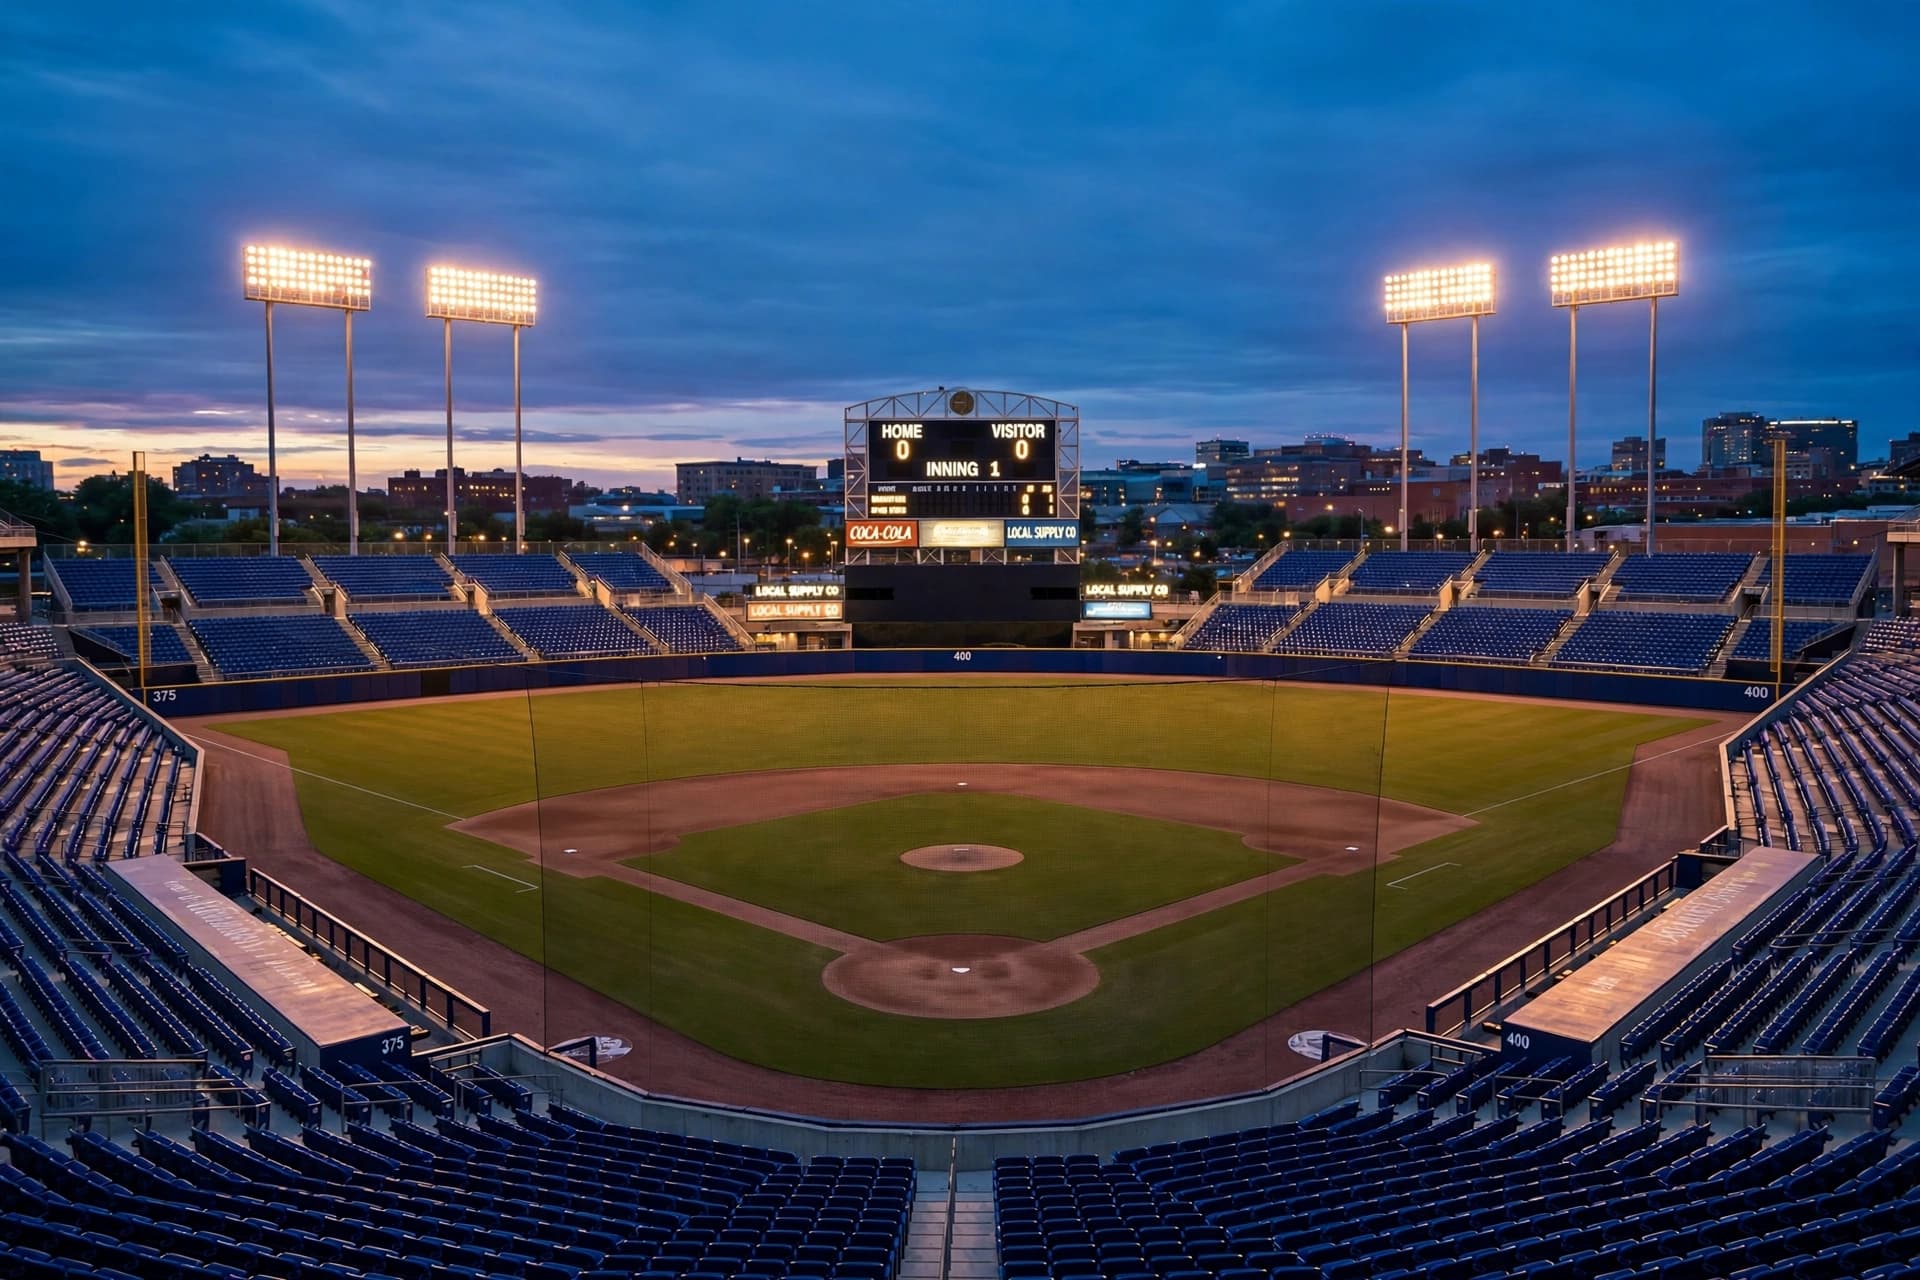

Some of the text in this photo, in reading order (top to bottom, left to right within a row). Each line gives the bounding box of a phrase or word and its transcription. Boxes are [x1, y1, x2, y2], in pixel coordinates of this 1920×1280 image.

[881, 424, 923, 439] HOME
[991, 423, 1046, 439] VISITOR
[896, 440, 910, 460] 0
[1015, 440, 1029, 460] 0
[926, 461, 1000, 477] INNING 1
[850, 525, 912, 540] COCA-COLA
[1007, 526, 1077, 539] LOCAL SUPPLY CO
[755, 585, 839, 597] LOCAL SUPPLY CO
[1086, 584, 1116, 595] LOCAL
[1118, 584, 1154, 595] SUPPLY
[751, 604, 784, 617] LOCAL
[953, 651, 972, 661] 400
[153, 689, 177, 702] 375
[1744, 686, 1769, 699] 400
[382, 1035, 404, 1055] 375
[1507, 1032, 1530, 1050] 400
